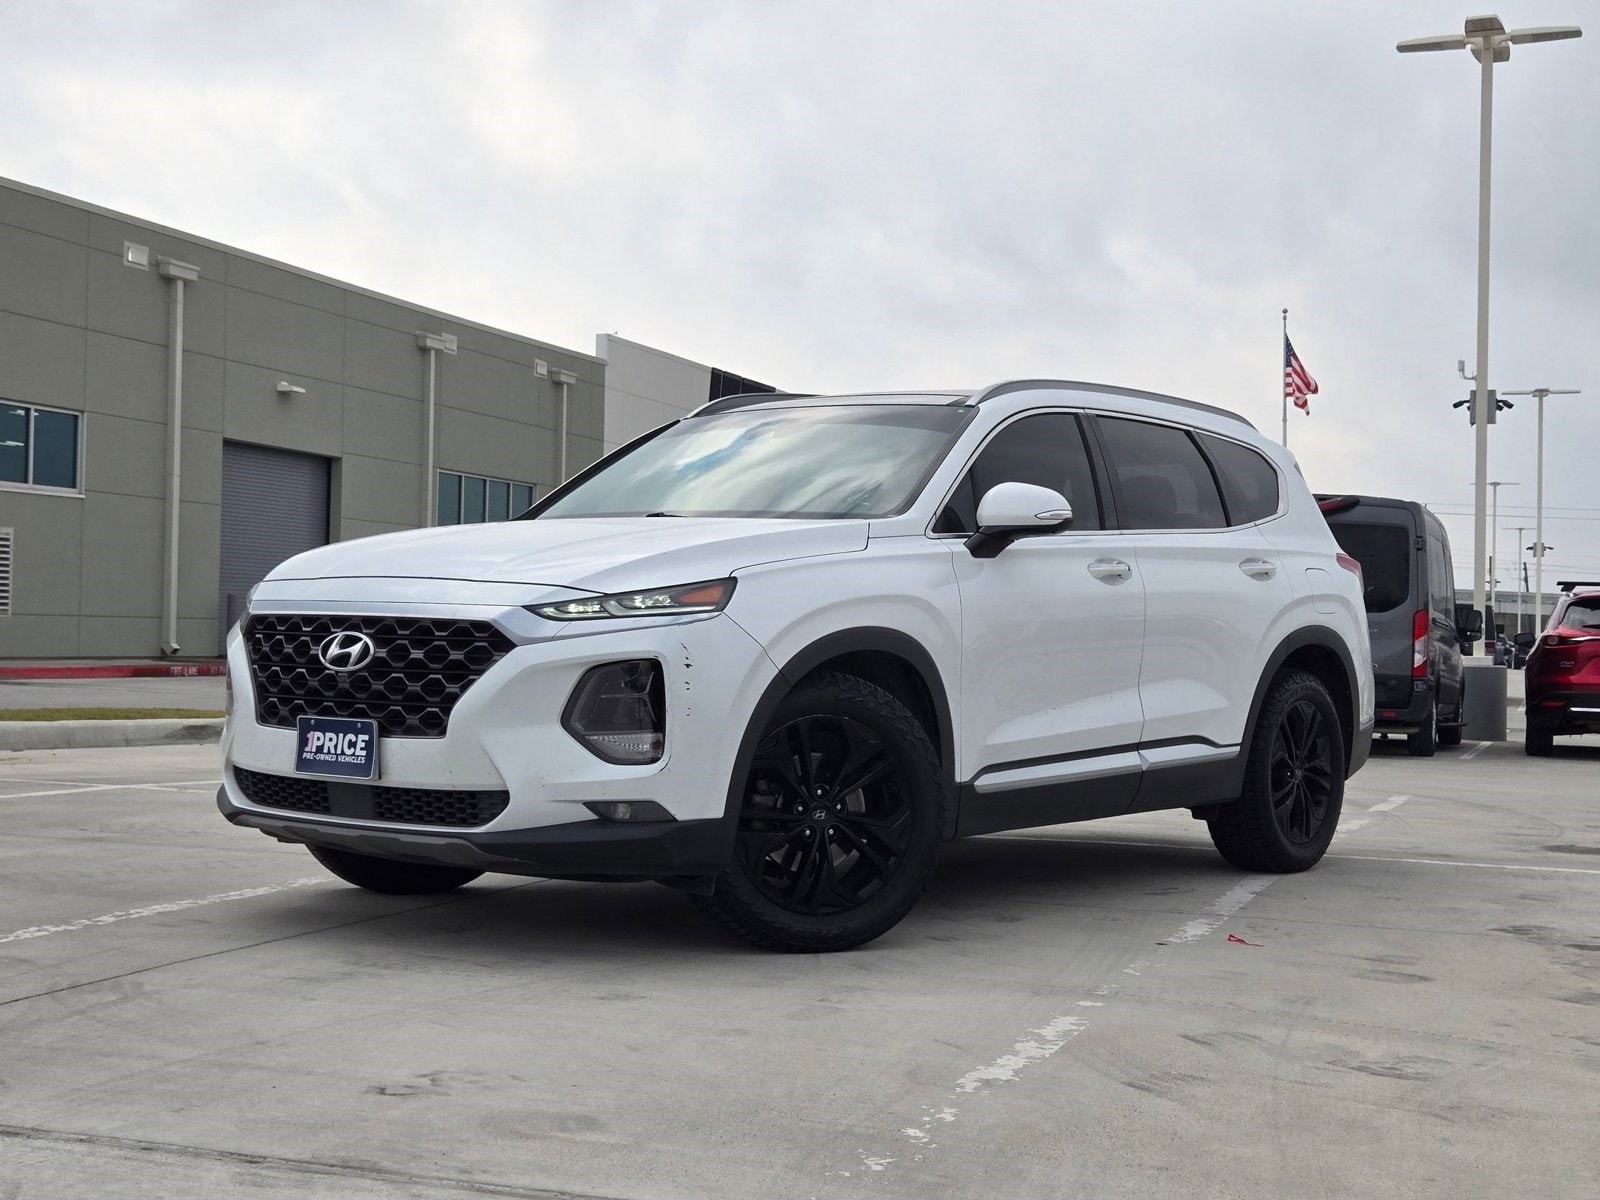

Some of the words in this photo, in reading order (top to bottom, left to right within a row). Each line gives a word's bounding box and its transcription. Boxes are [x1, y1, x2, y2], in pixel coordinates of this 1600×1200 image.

[304, 731, 369, 756] 1PRICE
[303, 753, 336, 762] PRE-OWNED
[338, 754, 365, 764] VEHICLES
